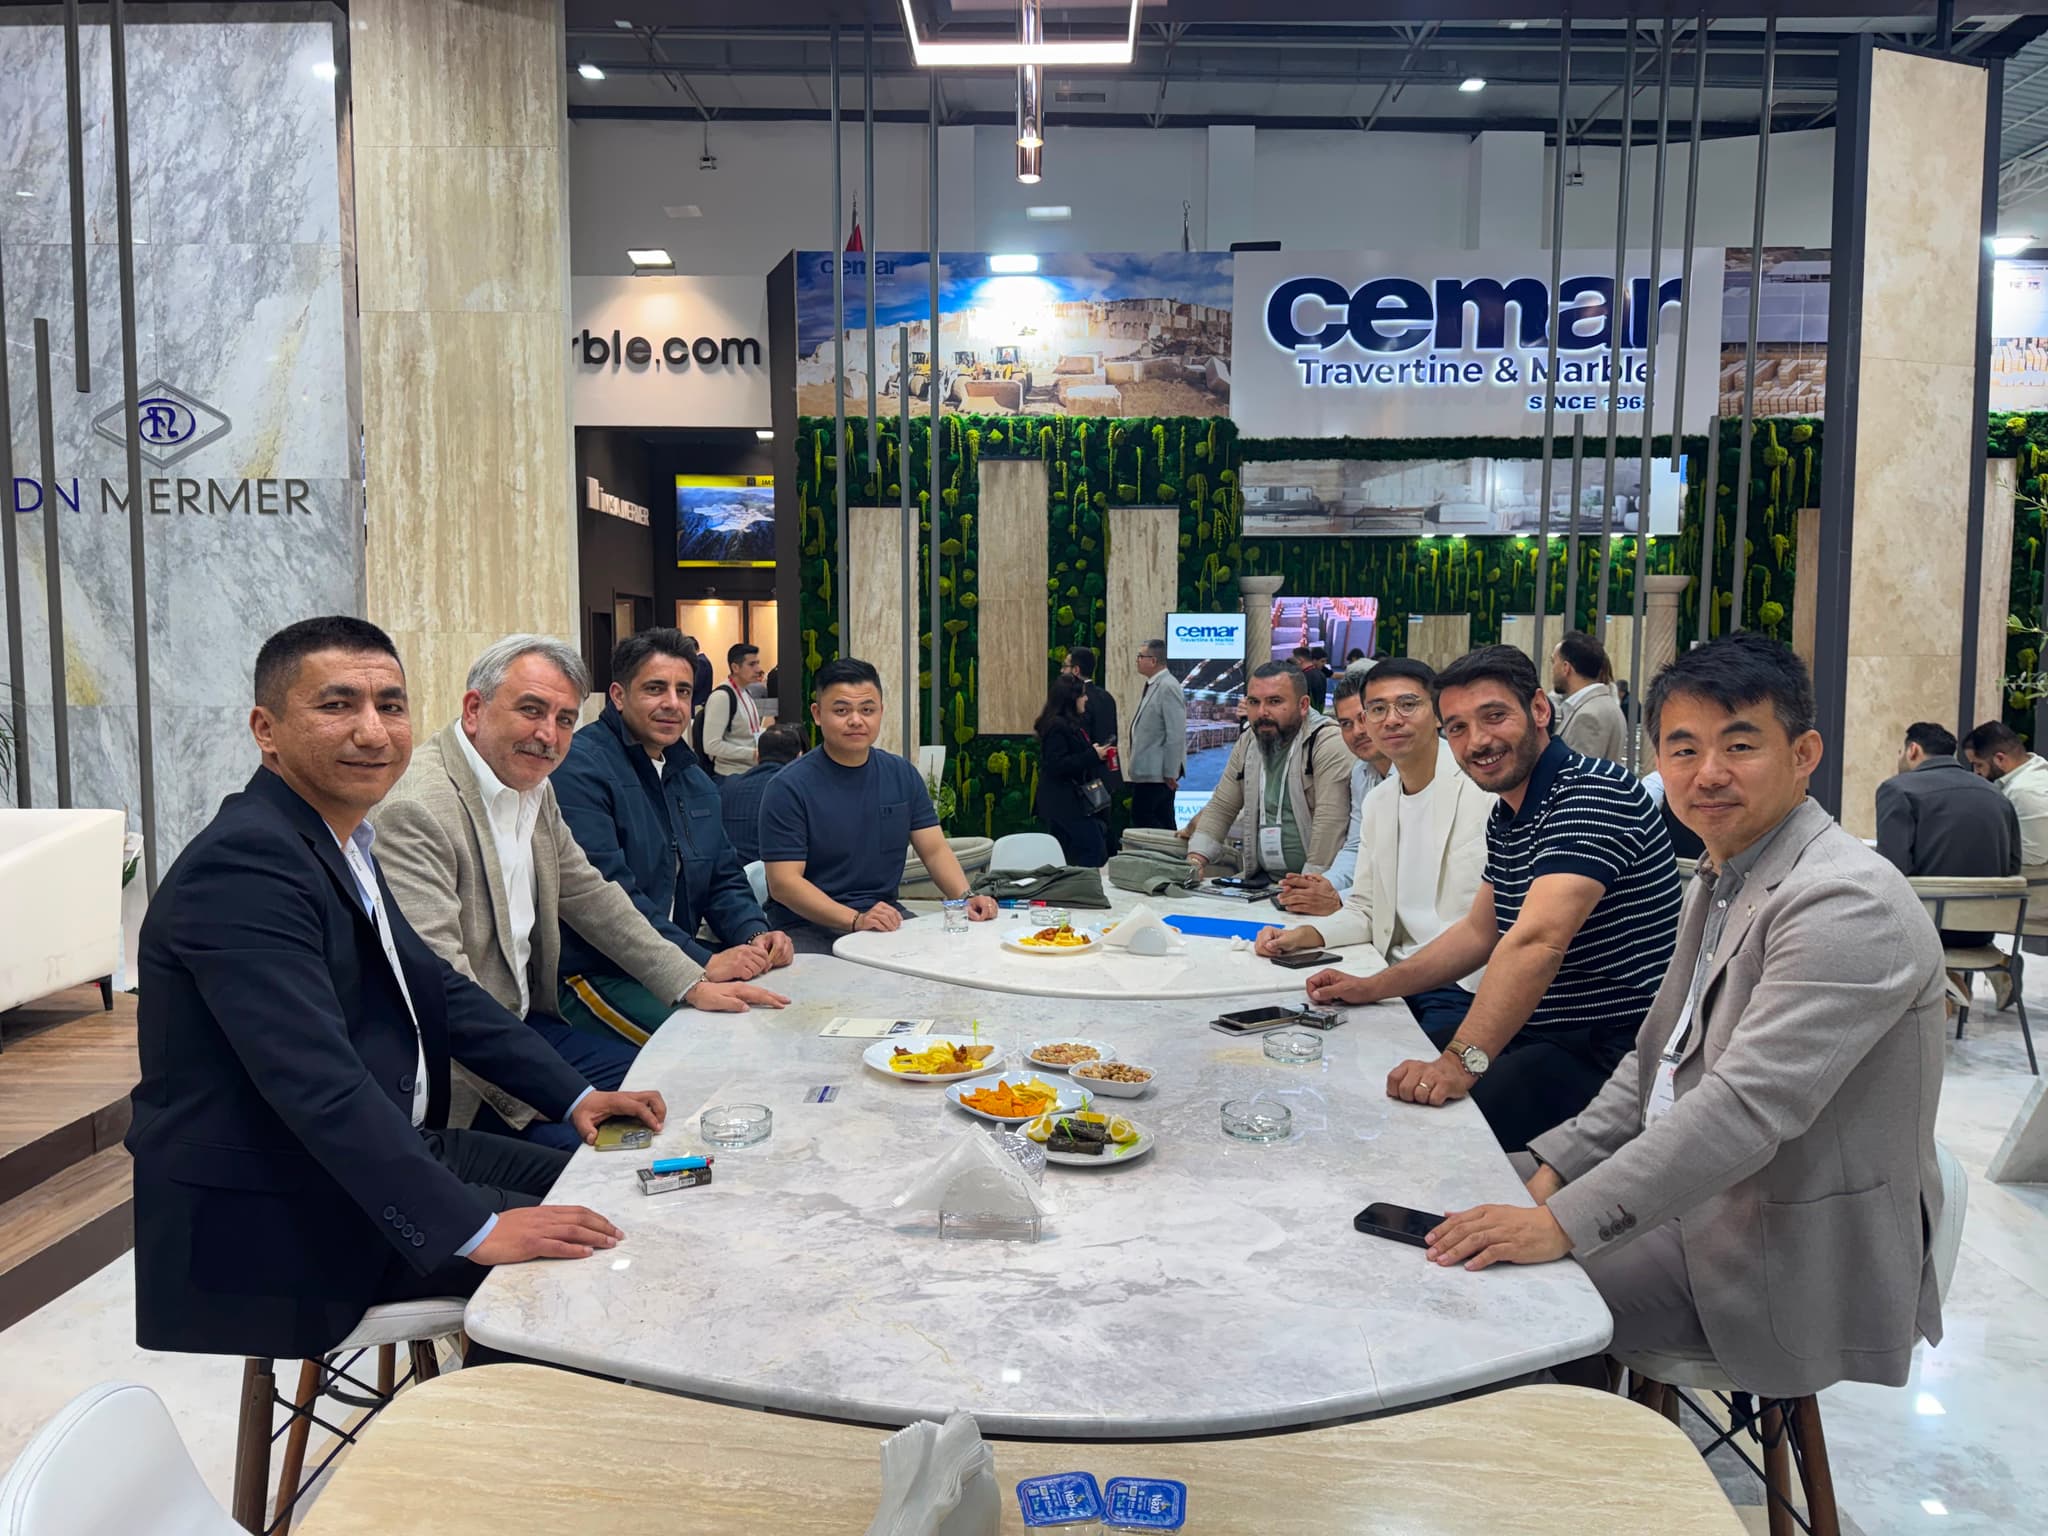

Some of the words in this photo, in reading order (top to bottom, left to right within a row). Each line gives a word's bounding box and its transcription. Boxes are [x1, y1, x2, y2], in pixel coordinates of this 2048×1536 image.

[1267, 276, 1686, 350] cemar
[1298, 354, 1483, 384] Travertine
[1495, 357, 1519, 384] &
[1531, 355, 1657, 383] Marble
[1529, 396, 1597, 409] SNCE
[101, 478, 311, 514] MERMER
[1175, 626, 1239, 637] cemar
